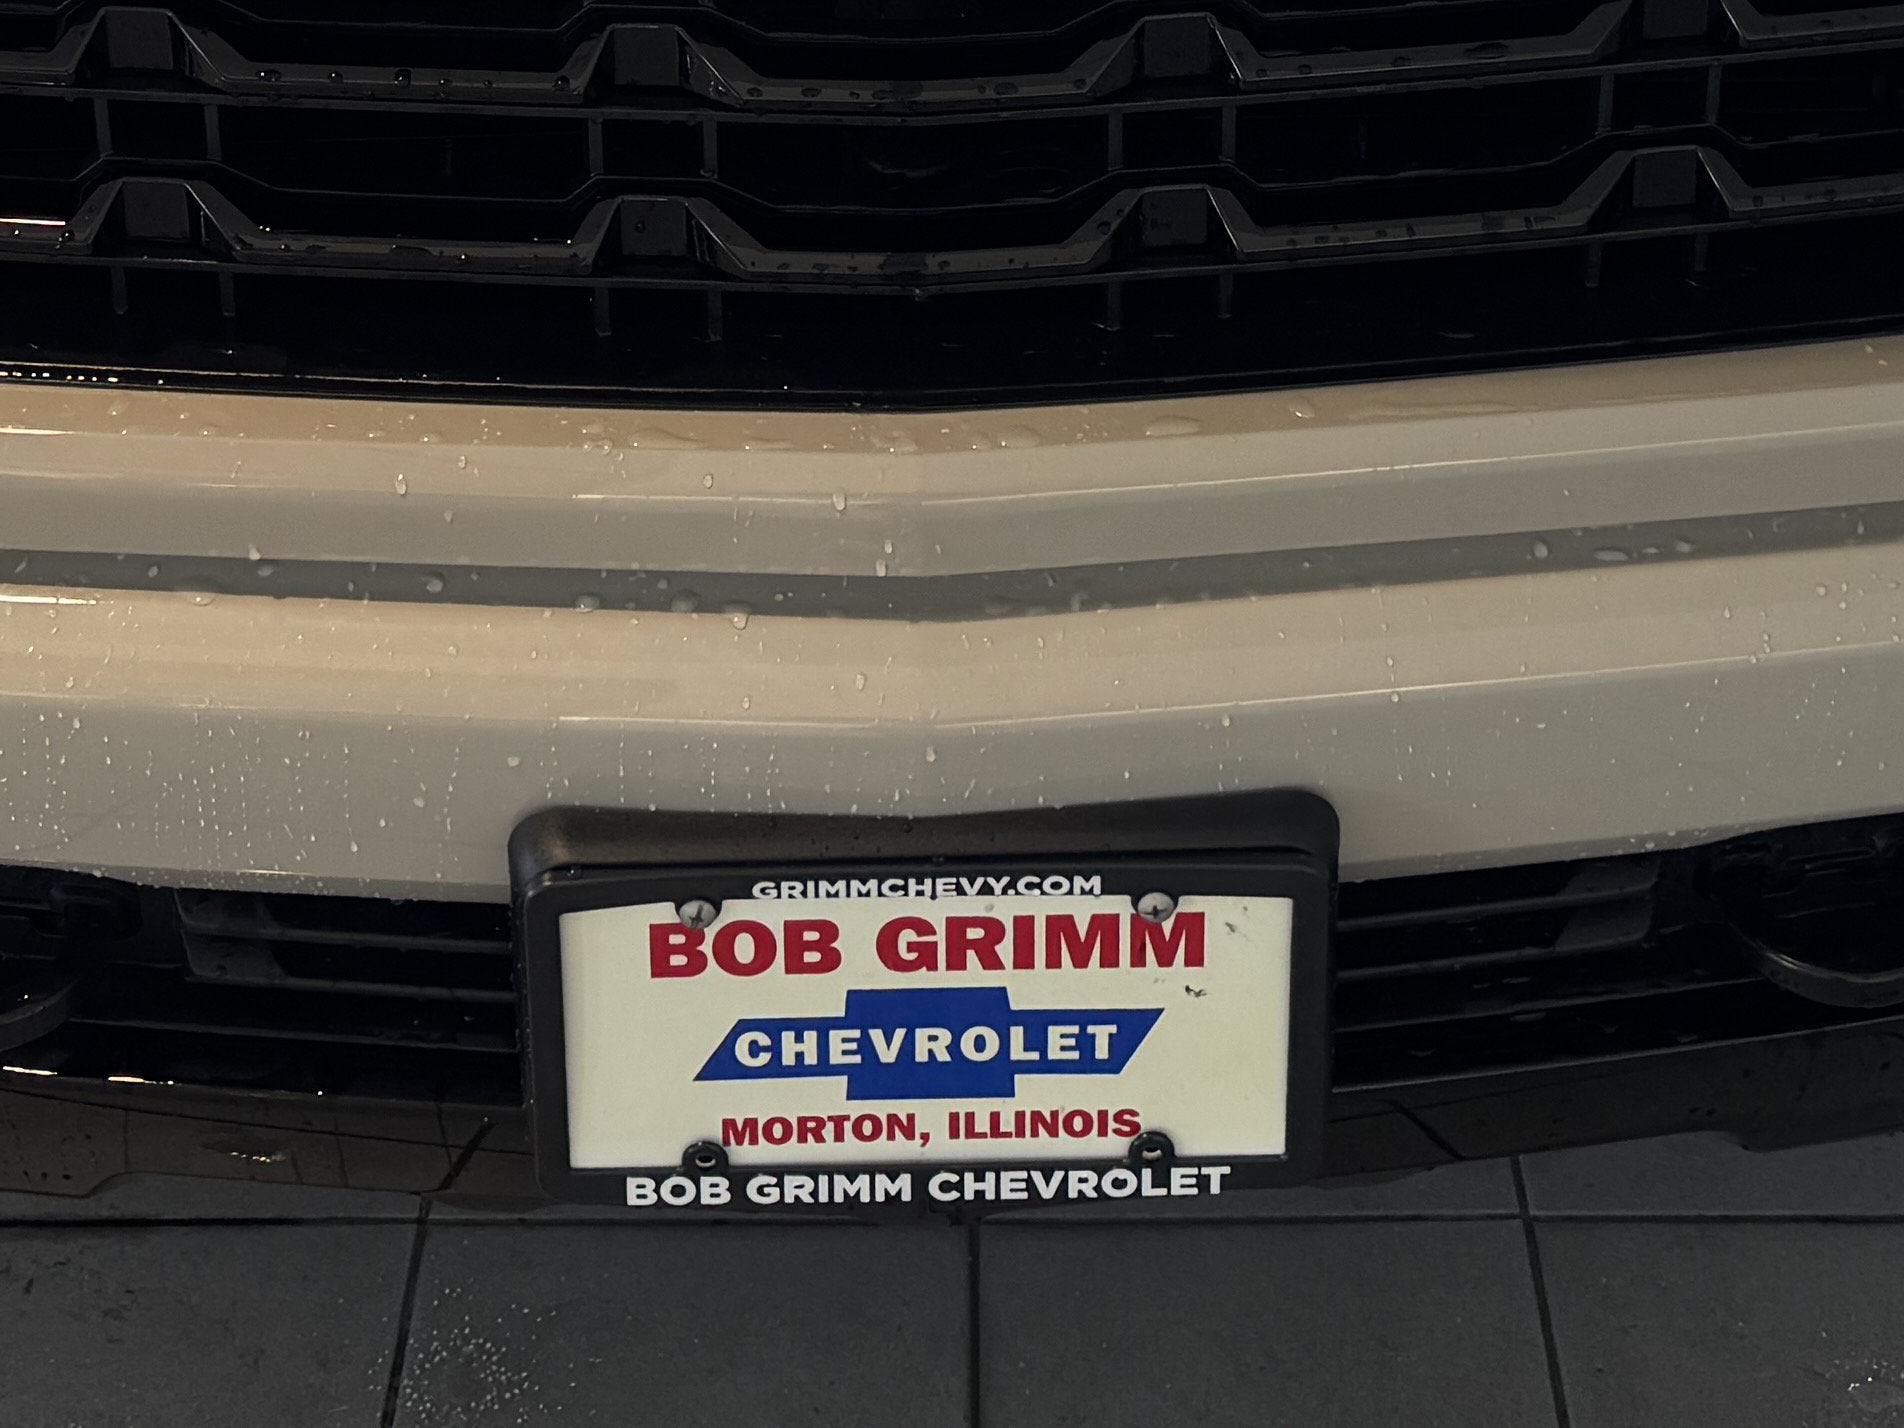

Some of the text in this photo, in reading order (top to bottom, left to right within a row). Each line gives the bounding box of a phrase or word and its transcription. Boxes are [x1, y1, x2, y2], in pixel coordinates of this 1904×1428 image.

[751, 875, 1102, 900] GRIMMCHEVY.COM
[649, 911, 1205, 979] BOB GRIMM
[734, 1024, 1117, 1067] CHEVROLET
[722, 1108, 1142, 1148] MORTON, ILLINOIS
[626, 1165, 1231, 1206] BOB GRIMM CHEVROLET
